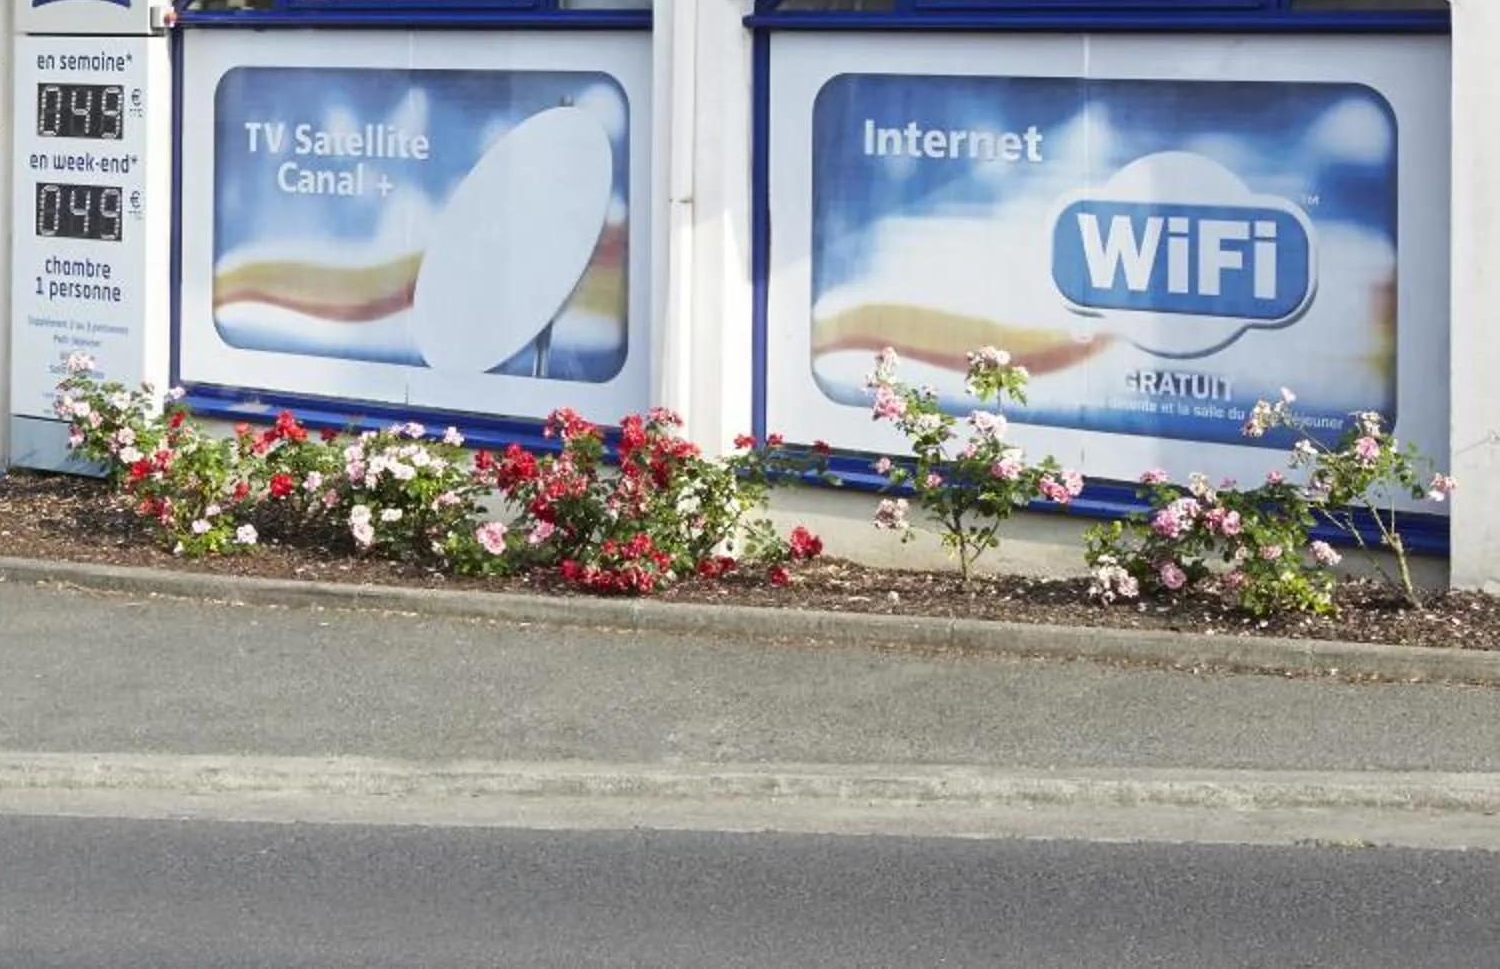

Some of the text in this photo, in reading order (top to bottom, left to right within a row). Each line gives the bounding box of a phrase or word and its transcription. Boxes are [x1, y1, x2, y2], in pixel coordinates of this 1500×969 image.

[37, 55, 55, 70] en
[40, 87, 142, 139] 049 €
[244, 122, 430, 159] TV Satellite
[864, 118, 1043, 163] Internet
[30, 154, 48, 169] en
[277, 161, 393, 196] Canal +
[40, 185, 141, 240] 049 €
[45, 256, 111, 279] chambre
[1077, 213, 1277, 300] WiFi
[36, 276, 121, 302] 1 personne
[1126, 370, 1233, 401] GRATUIT
[1228, 406, 1245, 420] du
